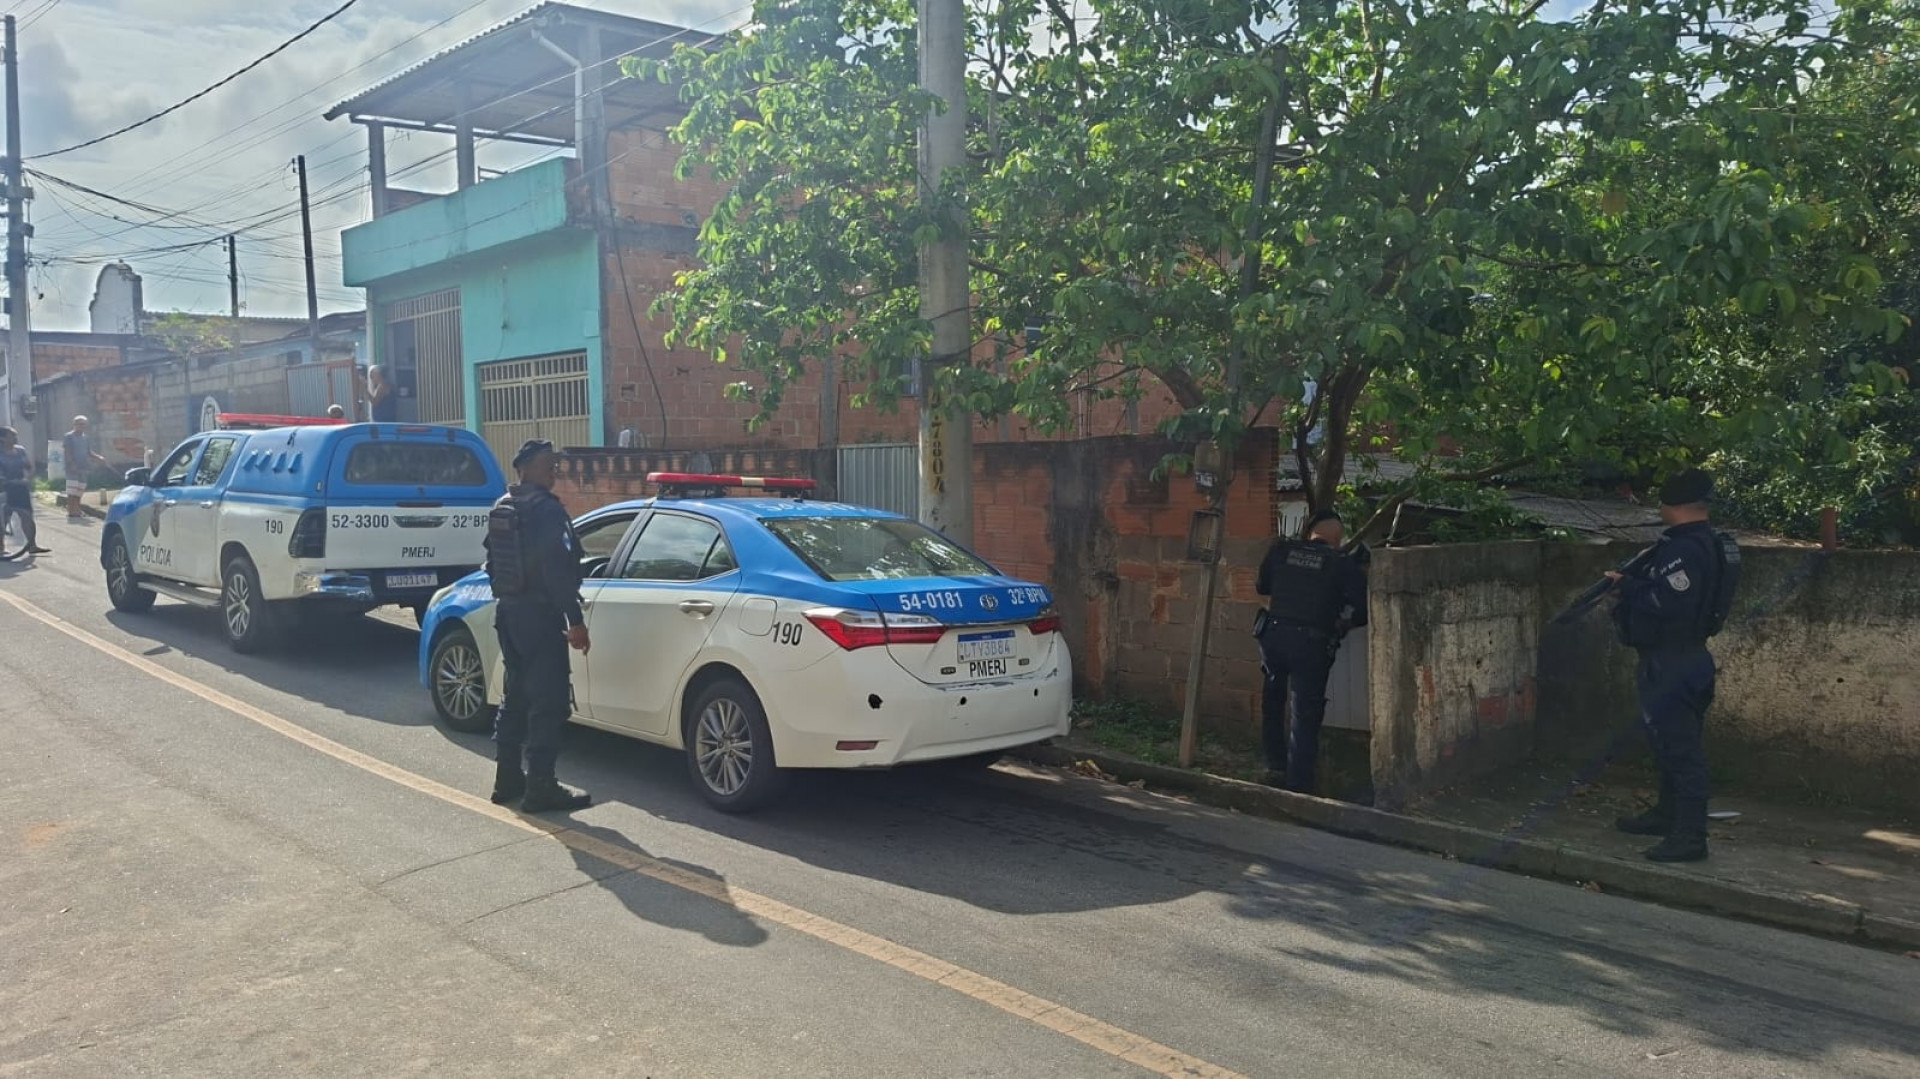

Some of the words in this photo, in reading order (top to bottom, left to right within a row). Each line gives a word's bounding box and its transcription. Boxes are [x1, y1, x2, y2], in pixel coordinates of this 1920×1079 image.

[265, 519, 284, 535] 190
[332, 514, 389, 528] 52-3300
[452, 514, 489, 528] 32°BP
[401, 546, 435, 559] PMERJ
[899, 591, 963, 611] 54-0181
[772, 621, 803, 646] 190
[969, 657, 1007, 678] PMERJ
